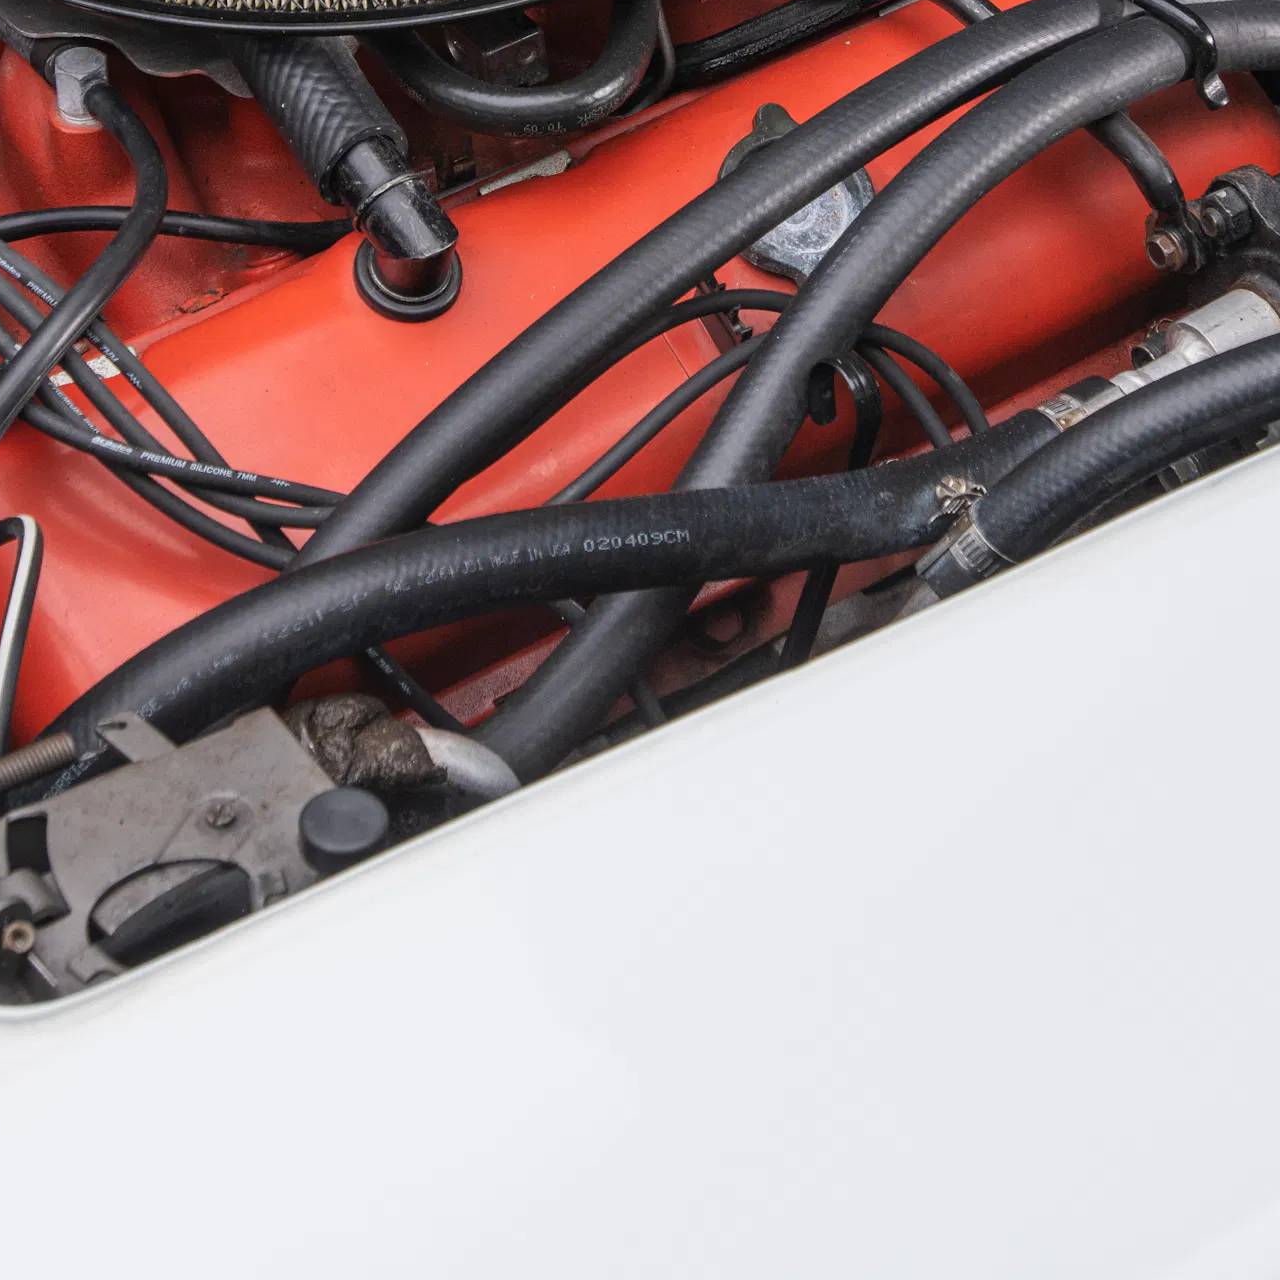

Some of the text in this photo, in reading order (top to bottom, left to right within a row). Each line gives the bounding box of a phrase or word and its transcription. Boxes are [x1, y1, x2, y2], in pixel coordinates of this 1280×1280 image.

[27, 281, 59, 308] PREMIU
[100, 345, 119, 363] 7MM
[140, 451, 186, 469] PREMIUM
[189, 461, 233, 479] SILICONE
[236, 472, 258, 482] 7MM
[548, 546, 571, 559] USA
[583, 529, 690, 553] 020409CM
